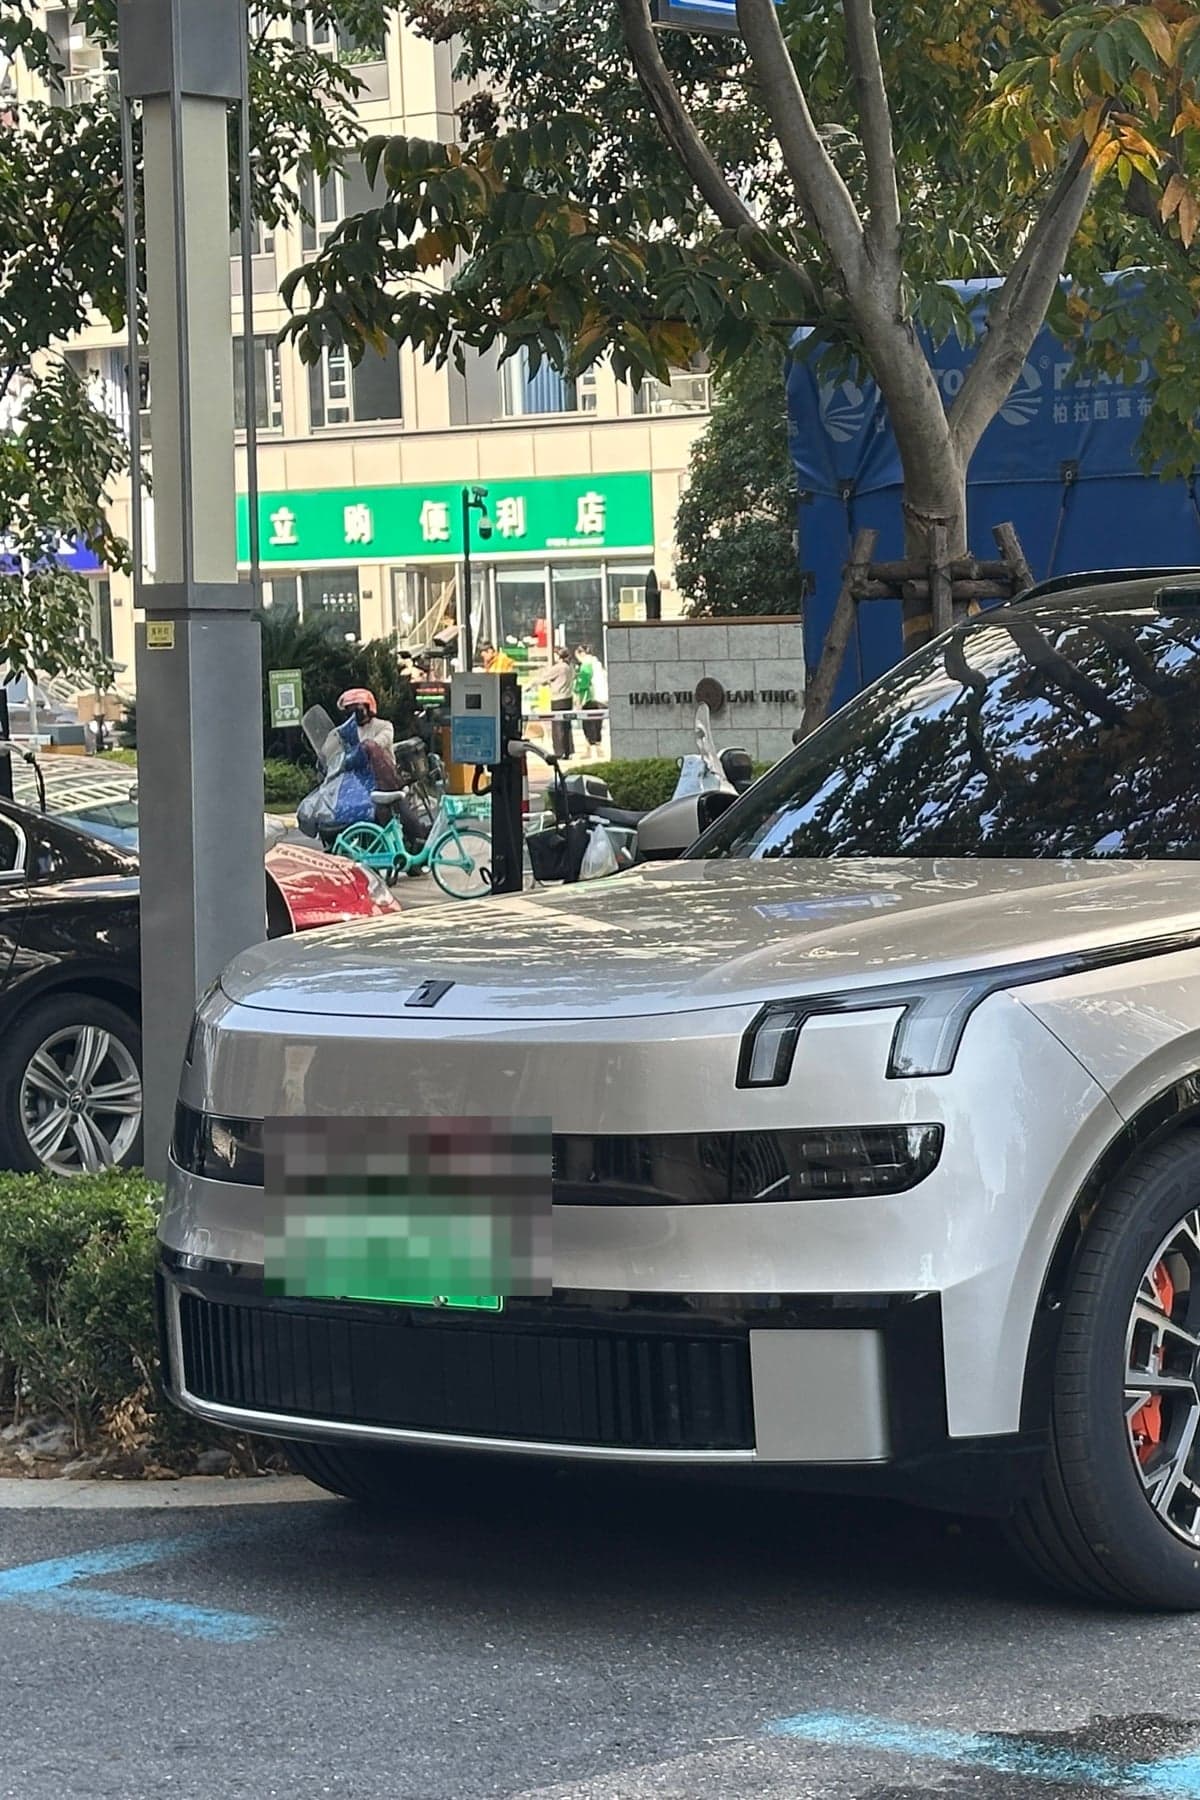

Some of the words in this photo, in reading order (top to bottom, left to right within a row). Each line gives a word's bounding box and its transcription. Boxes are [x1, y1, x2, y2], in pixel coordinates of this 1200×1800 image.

[269, 491, 606, 545] 立购便利店
